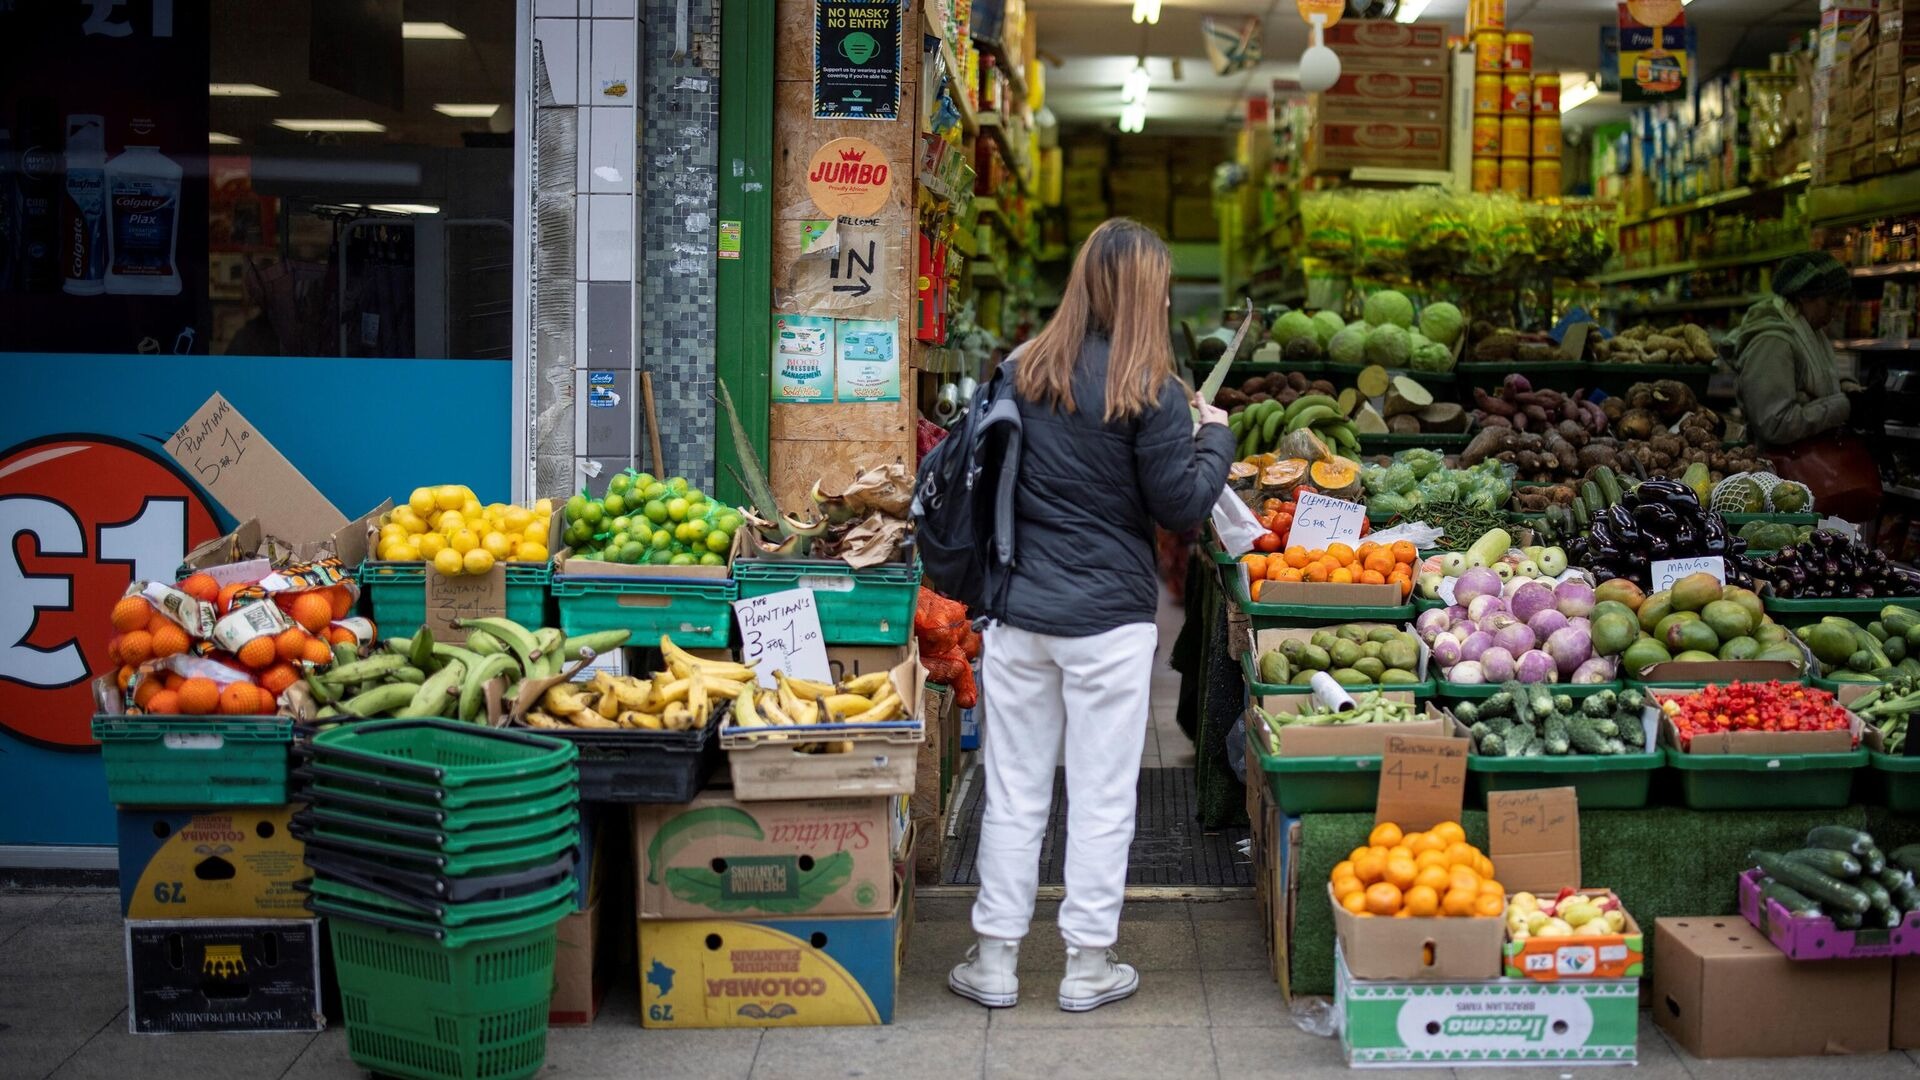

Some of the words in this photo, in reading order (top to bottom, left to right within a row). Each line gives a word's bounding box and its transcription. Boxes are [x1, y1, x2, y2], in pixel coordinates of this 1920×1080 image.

[828, 8, 846, 18] NO
[849, 8, 890, 19] MASK?
[828, 19, 846, 28] NO
[849, 19, 889, 29] ENTRY
[810, 161, 888, 186] JUMBO
[116, 197, 162, 210] Colgate
[129, 214, 157, 225] Plax
[837, 215, 880, 227] WELCOME
[72, 216, 85, 277] Colgate
[829, 240, 876, 279] IN
[592, 374, 613, 383] Lucky
[781, 369, 822, 380] MANAGEMENT
[194, 457, 220, 486] 5
[219, 455, 233, 468] FOR
[1301, 494, 1359, 513] CLEMENTINE
[1298, 507, 1312, 527] 6
[1313, 520, 1326, 528] FOR
[1667, 559, 1710, 573] MANGO
[432, 598, 458, 623] 3
[738, 598, 810, 627] PLANTIAN'S
[747, 631, 763, 657] 3
[767, 639, 787, 652] FOR
[1387, 760, 1412, 791] 4
[1502, 811, 1520, 834] 2
[181, 831, 245, 842] COLOMBA
[771, 820, 874, 852] Selvática
[730, 865, 786, 880] PLANTAINS
[154, 882, 187, 904] 79
[731, 879, 787, 893] PREMIUM
[730, 949, 801, 961] PLANTAIN
[1531, 957, 1547, 967] 24
[732, 962, 800, 973] PREMIUM
[707, 977, 826, 998] COLOMBA
[649, 1005, 674, 1022] 79
[1456, 1002, 1481, 1011] YAMS
[1485, 1002, 1536, 1011] BRAZILIAN
[169, 1011, 224, 1023] PREMIUM
[1444, 1015, 1547, 1041] Iracema
